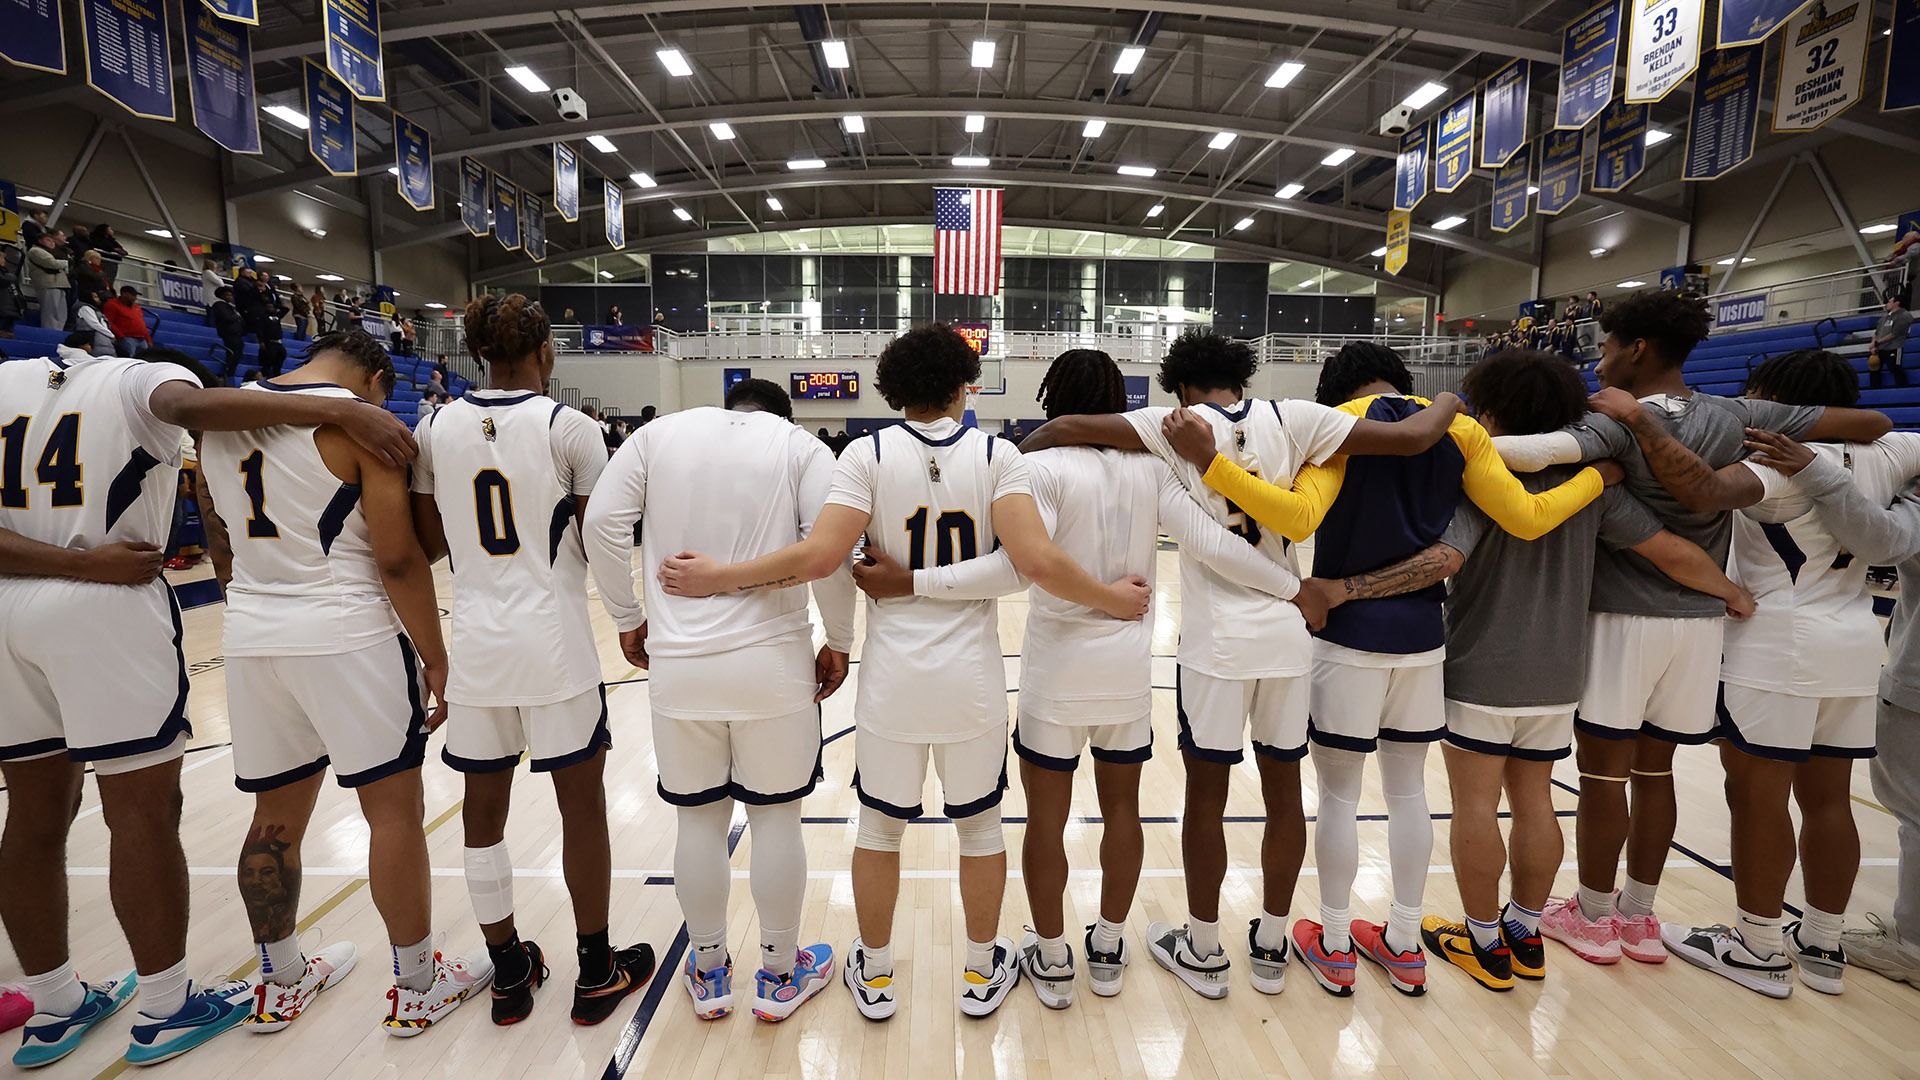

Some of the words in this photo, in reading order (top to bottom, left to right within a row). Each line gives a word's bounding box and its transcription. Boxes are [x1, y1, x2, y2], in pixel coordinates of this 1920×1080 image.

[1652, 7, 1678, 43] 33
[1643, 36, 1682, 64] BRENDAN
[1806, 37, 1839, 74] 32
[1649, 52, 1674, 73] KELLY
[1795, 66, 1845, 95] DESHAWN
[1795, 80, 1841, 107] LOWMAN
[1808, 93, 1848, 114] Basketball
[1447, 156, 1460, 176] 18
[1614, 154, 1625, 174] 5
[1553, 180, 1566, 198] 10
[1505, 201, 1513, 216] 8
[1720, 300, 1764, 322] VISITOR
[800, 380, 807, 392] 0
[849, 380, 857, 392] 0
[809, 374, 838, 385] 20:00
[836, 390, 840, 398] 1
[0, 411, 84, 509] 14
[239, 448, 281, 539] 1
[472, 467, 521, 557] 0
[904, 505, 978, 571] 10
